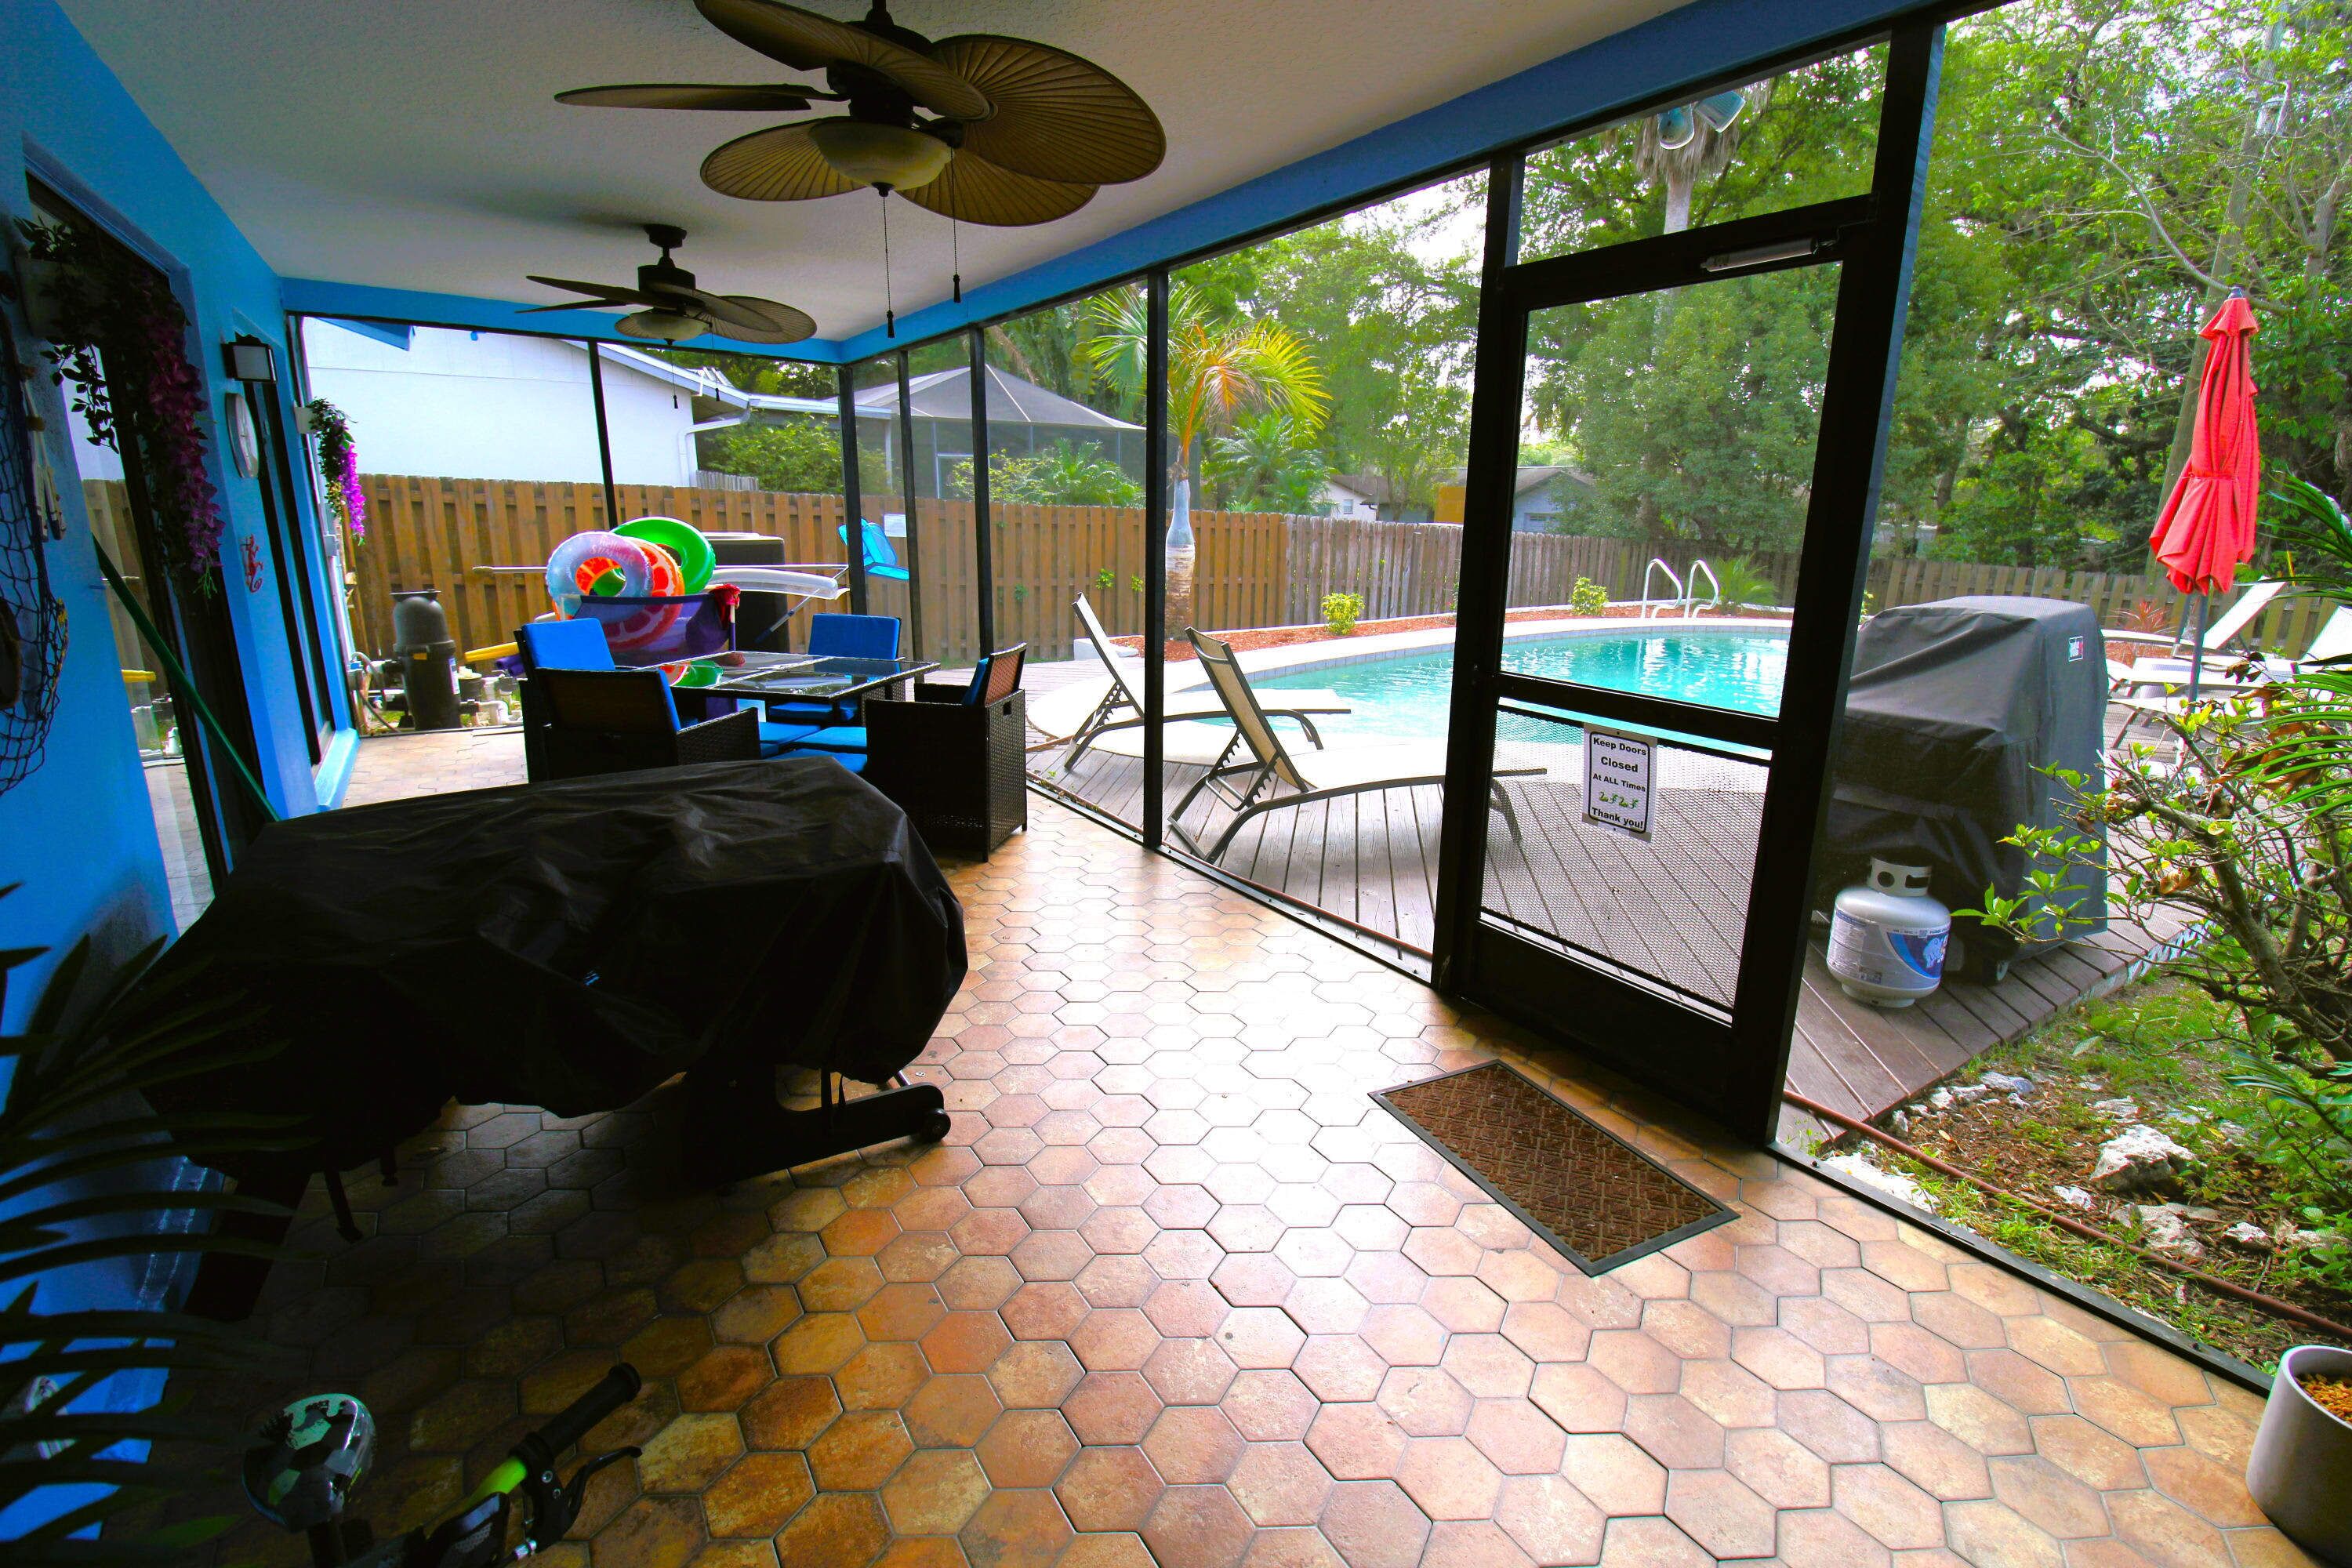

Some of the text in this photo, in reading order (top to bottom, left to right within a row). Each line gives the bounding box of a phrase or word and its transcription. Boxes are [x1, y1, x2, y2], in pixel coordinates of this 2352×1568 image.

[1593, 737, 1646, 755] Keep Doors
[1601, 757, 1638, 772] Closed
[1604, 776, 1619, 785] ALL
[1621, 780, 1646, 792] Times
[1592, 808, 1643, 829] Thank you!
